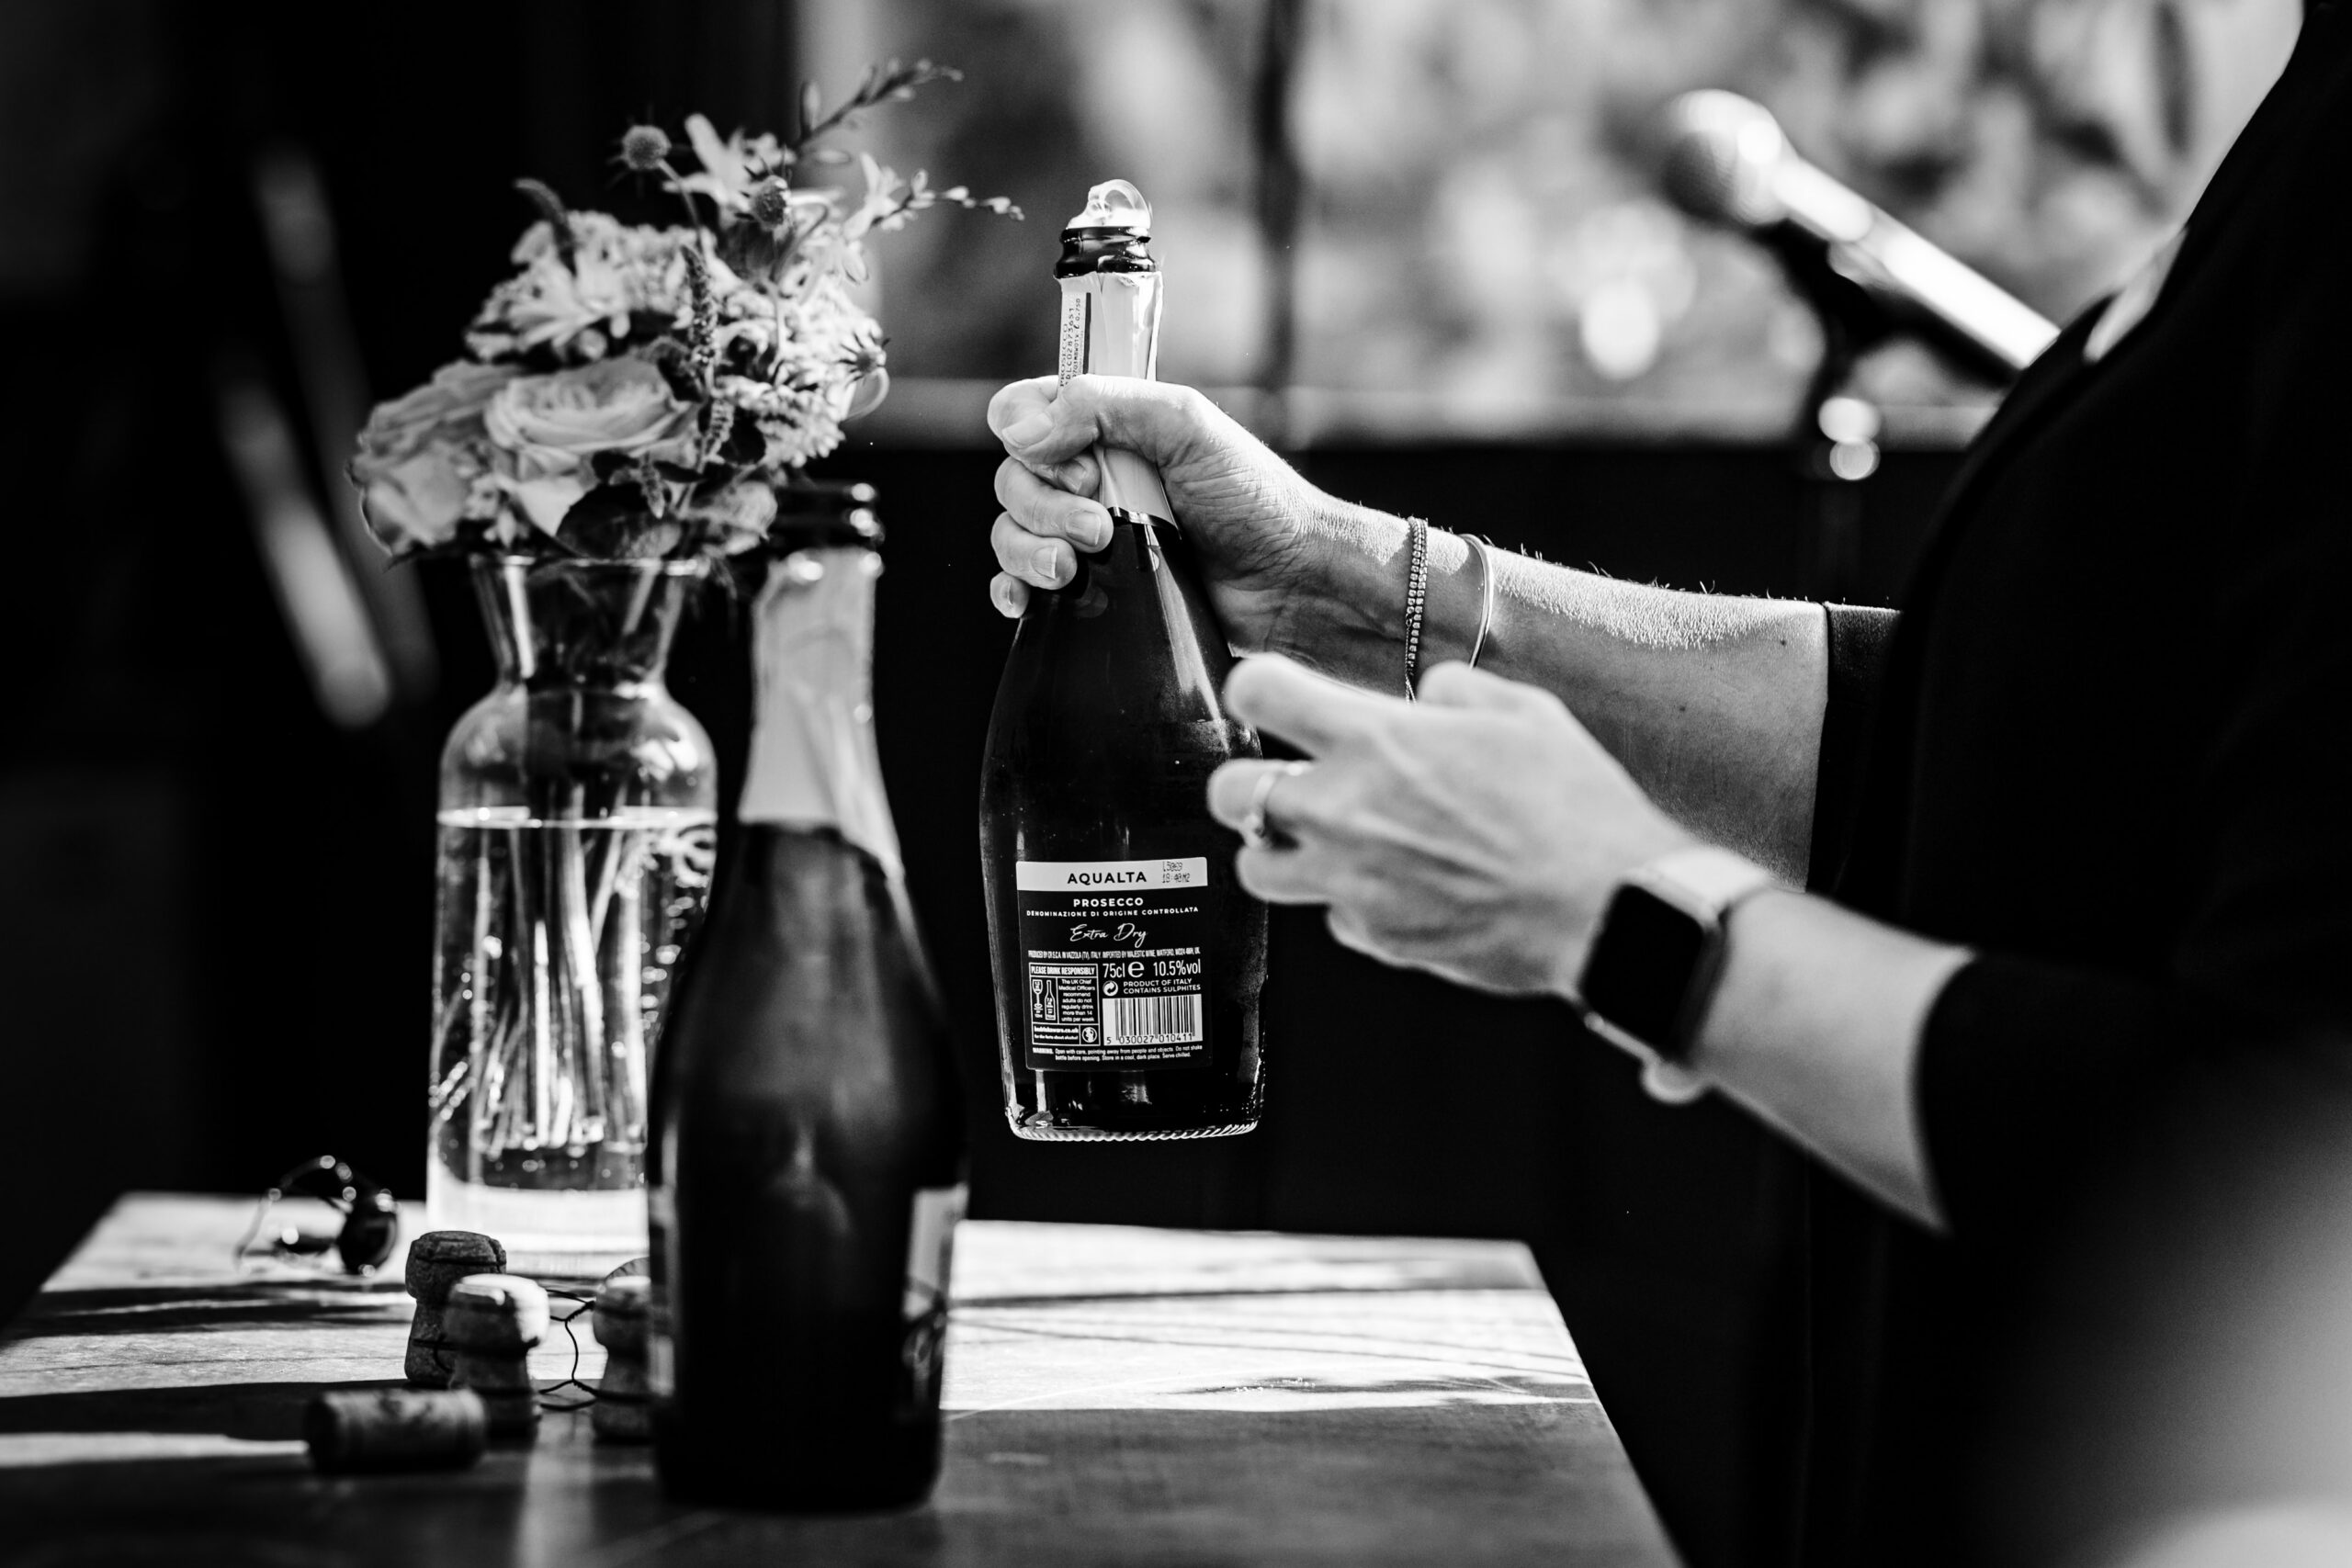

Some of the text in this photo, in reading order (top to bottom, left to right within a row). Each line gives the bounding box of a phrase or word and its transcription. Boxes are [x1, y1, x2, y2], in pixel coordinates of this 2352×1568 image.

[1059, 323, 1069, 388] PROSECCO
[1067, 872, 1148, 886] AQUALTA
[1073, 897, 1144, 908] PROSECCO
[1142, 907, 1199, 916] CONTROLLATA
[1069, 922, 1147, 949] Extra Dry
[1102, 962, 1125, 978] 75cl
[1123, 979, 1159, 987] PRODUCT
[1163, 984, 1201, 992] SULPHITES
[1106, 1033, 1193, 1044] 5 030027 010411
